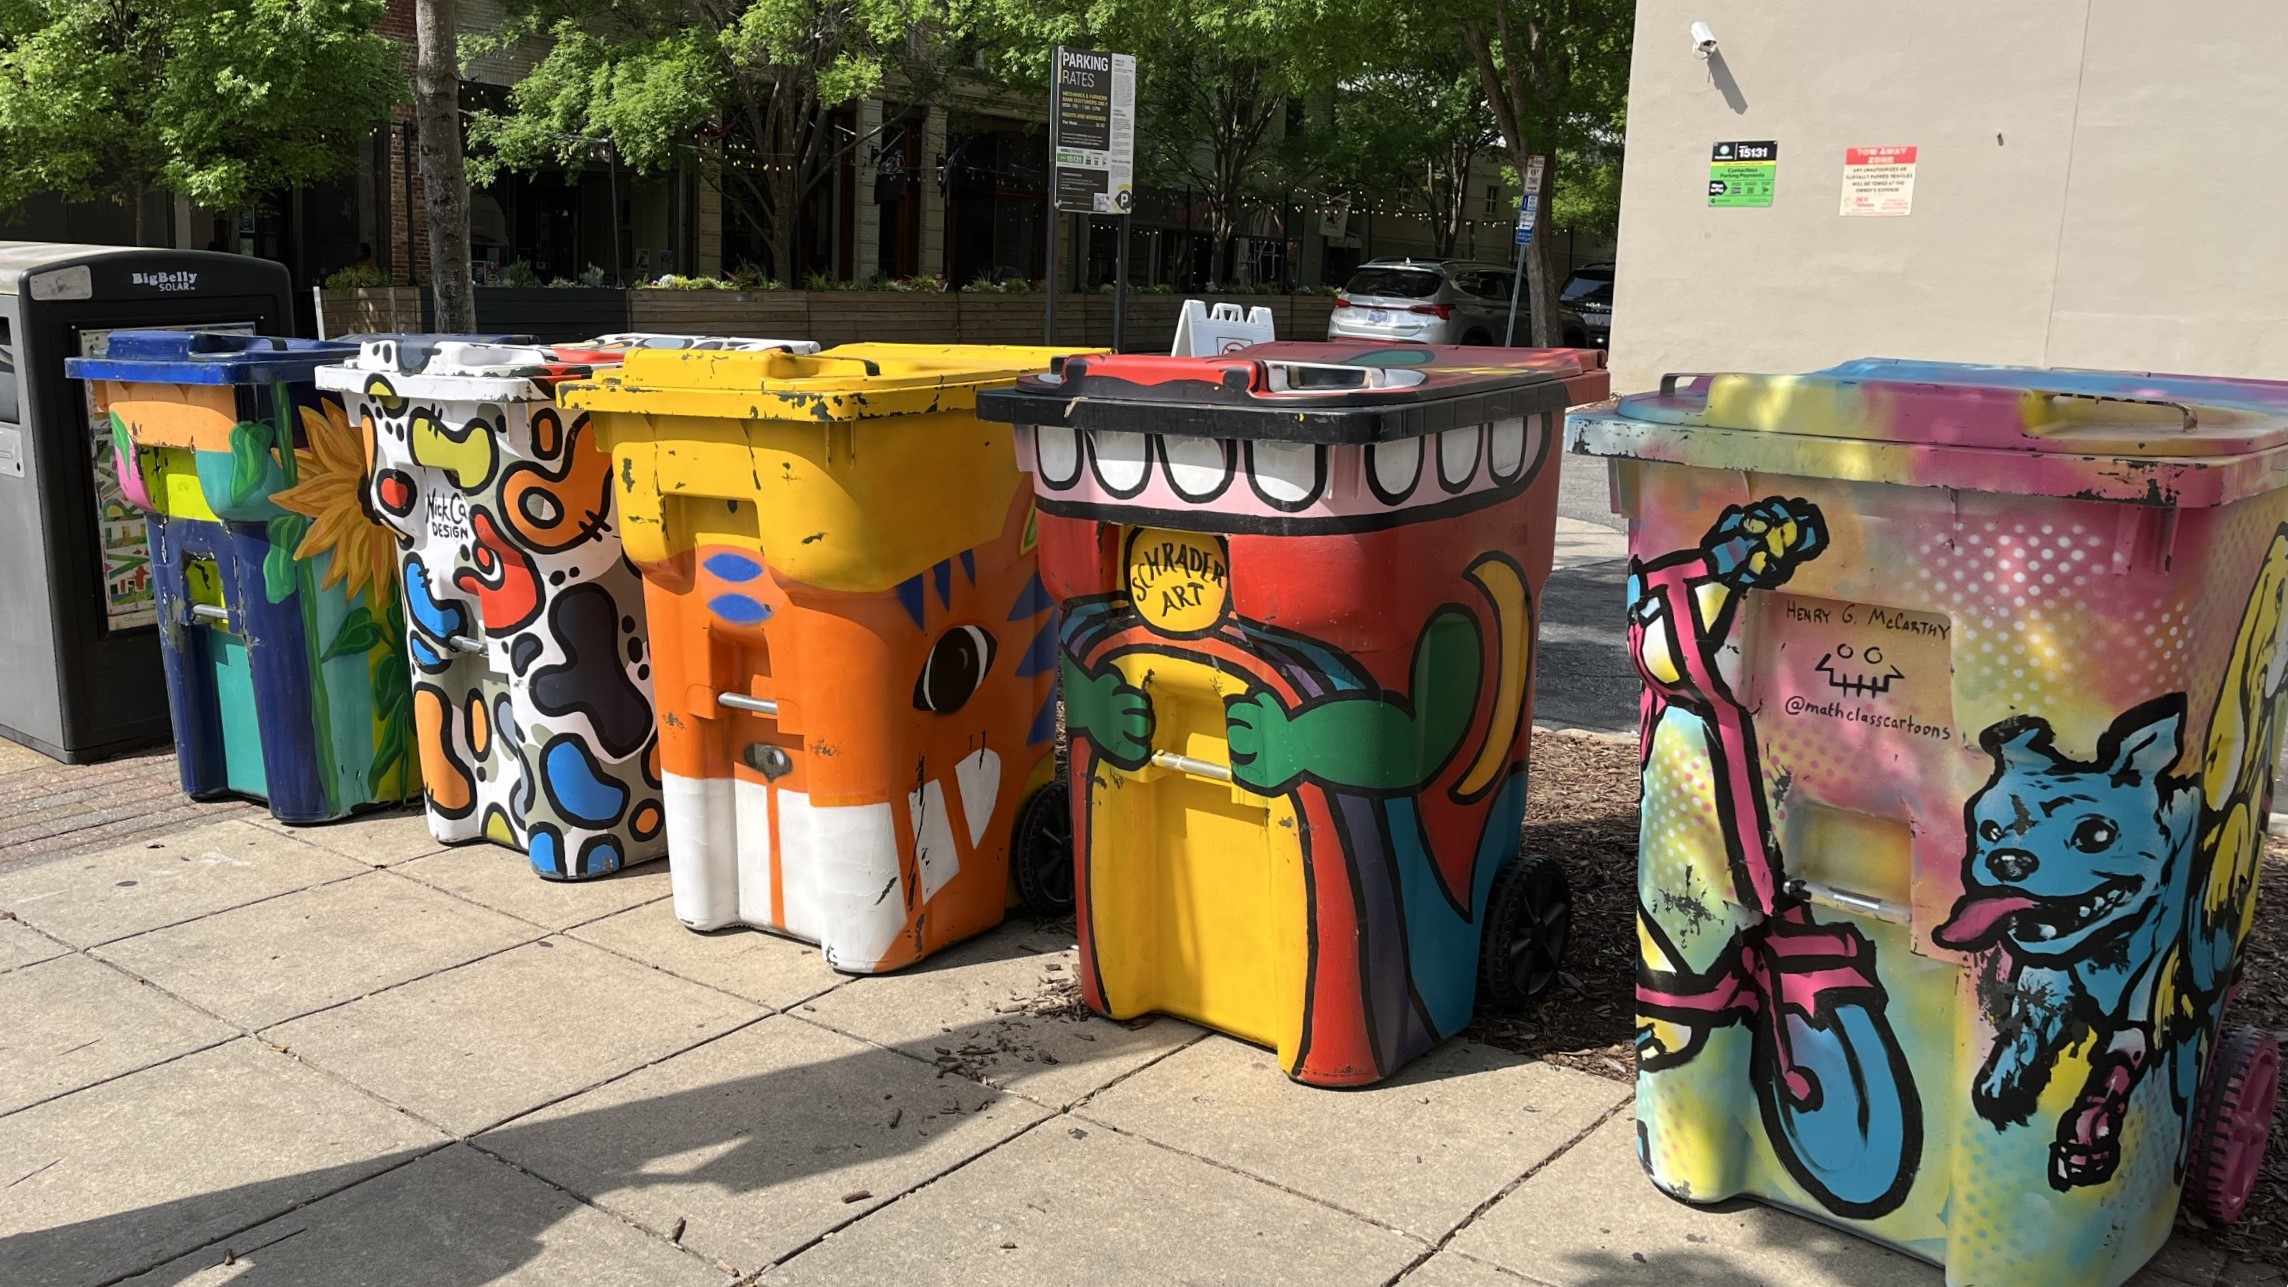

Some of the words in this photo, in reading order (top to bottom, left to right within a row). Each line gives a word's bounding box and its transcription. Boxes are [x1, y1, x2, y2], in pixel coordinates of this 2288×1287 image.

[1062, 52, 1108, 72] PARKING
[1062, 70, 1094, 88] RATES
[1739, 147, 1768, 158] 15131
[1857, 148, 1878, 156] TOW
[1880, 147, 1908, 155] AWAY
[132, 271, 197, 286] BigBelly
[159, 283, 189, 291] SOLAR
[432, 522, 469, 539] DESIGN
[1132, 543, 1225, 601] SCHRADER
[1162, 582, 1204, 616] ART
[1786, 600, 1831, 624] HENRY
[1842, 604, 1857, 624] G.
[1785, 695, 1951, 740] @mathclasscartoons
